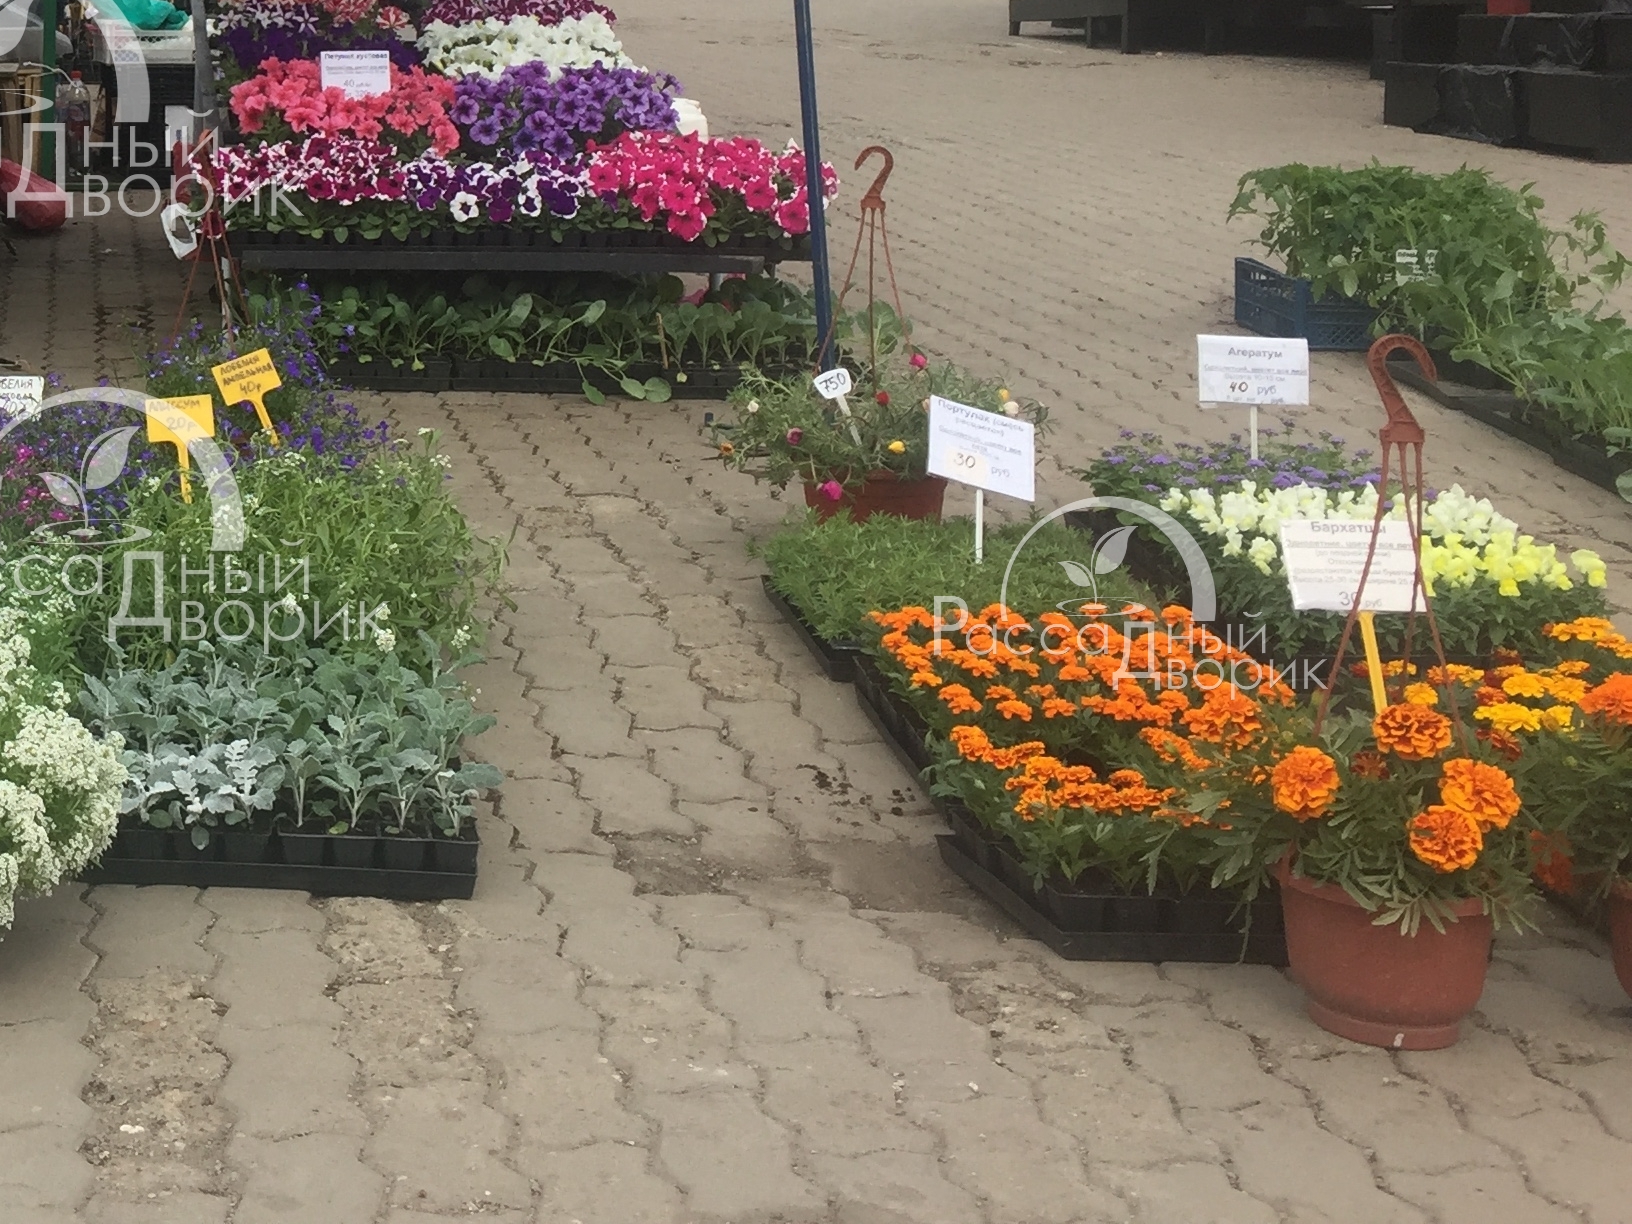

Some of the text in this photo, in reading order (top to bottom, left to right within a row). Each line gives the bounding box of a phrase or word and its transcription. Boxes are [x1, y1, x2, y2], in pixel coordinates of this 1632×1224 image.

[1228, 347, 1282, 359] Агератум
[819, 372, 847, 392] 750
[1229, 381, 1249, 392] 40
[953, 452, 976, 469] 30
